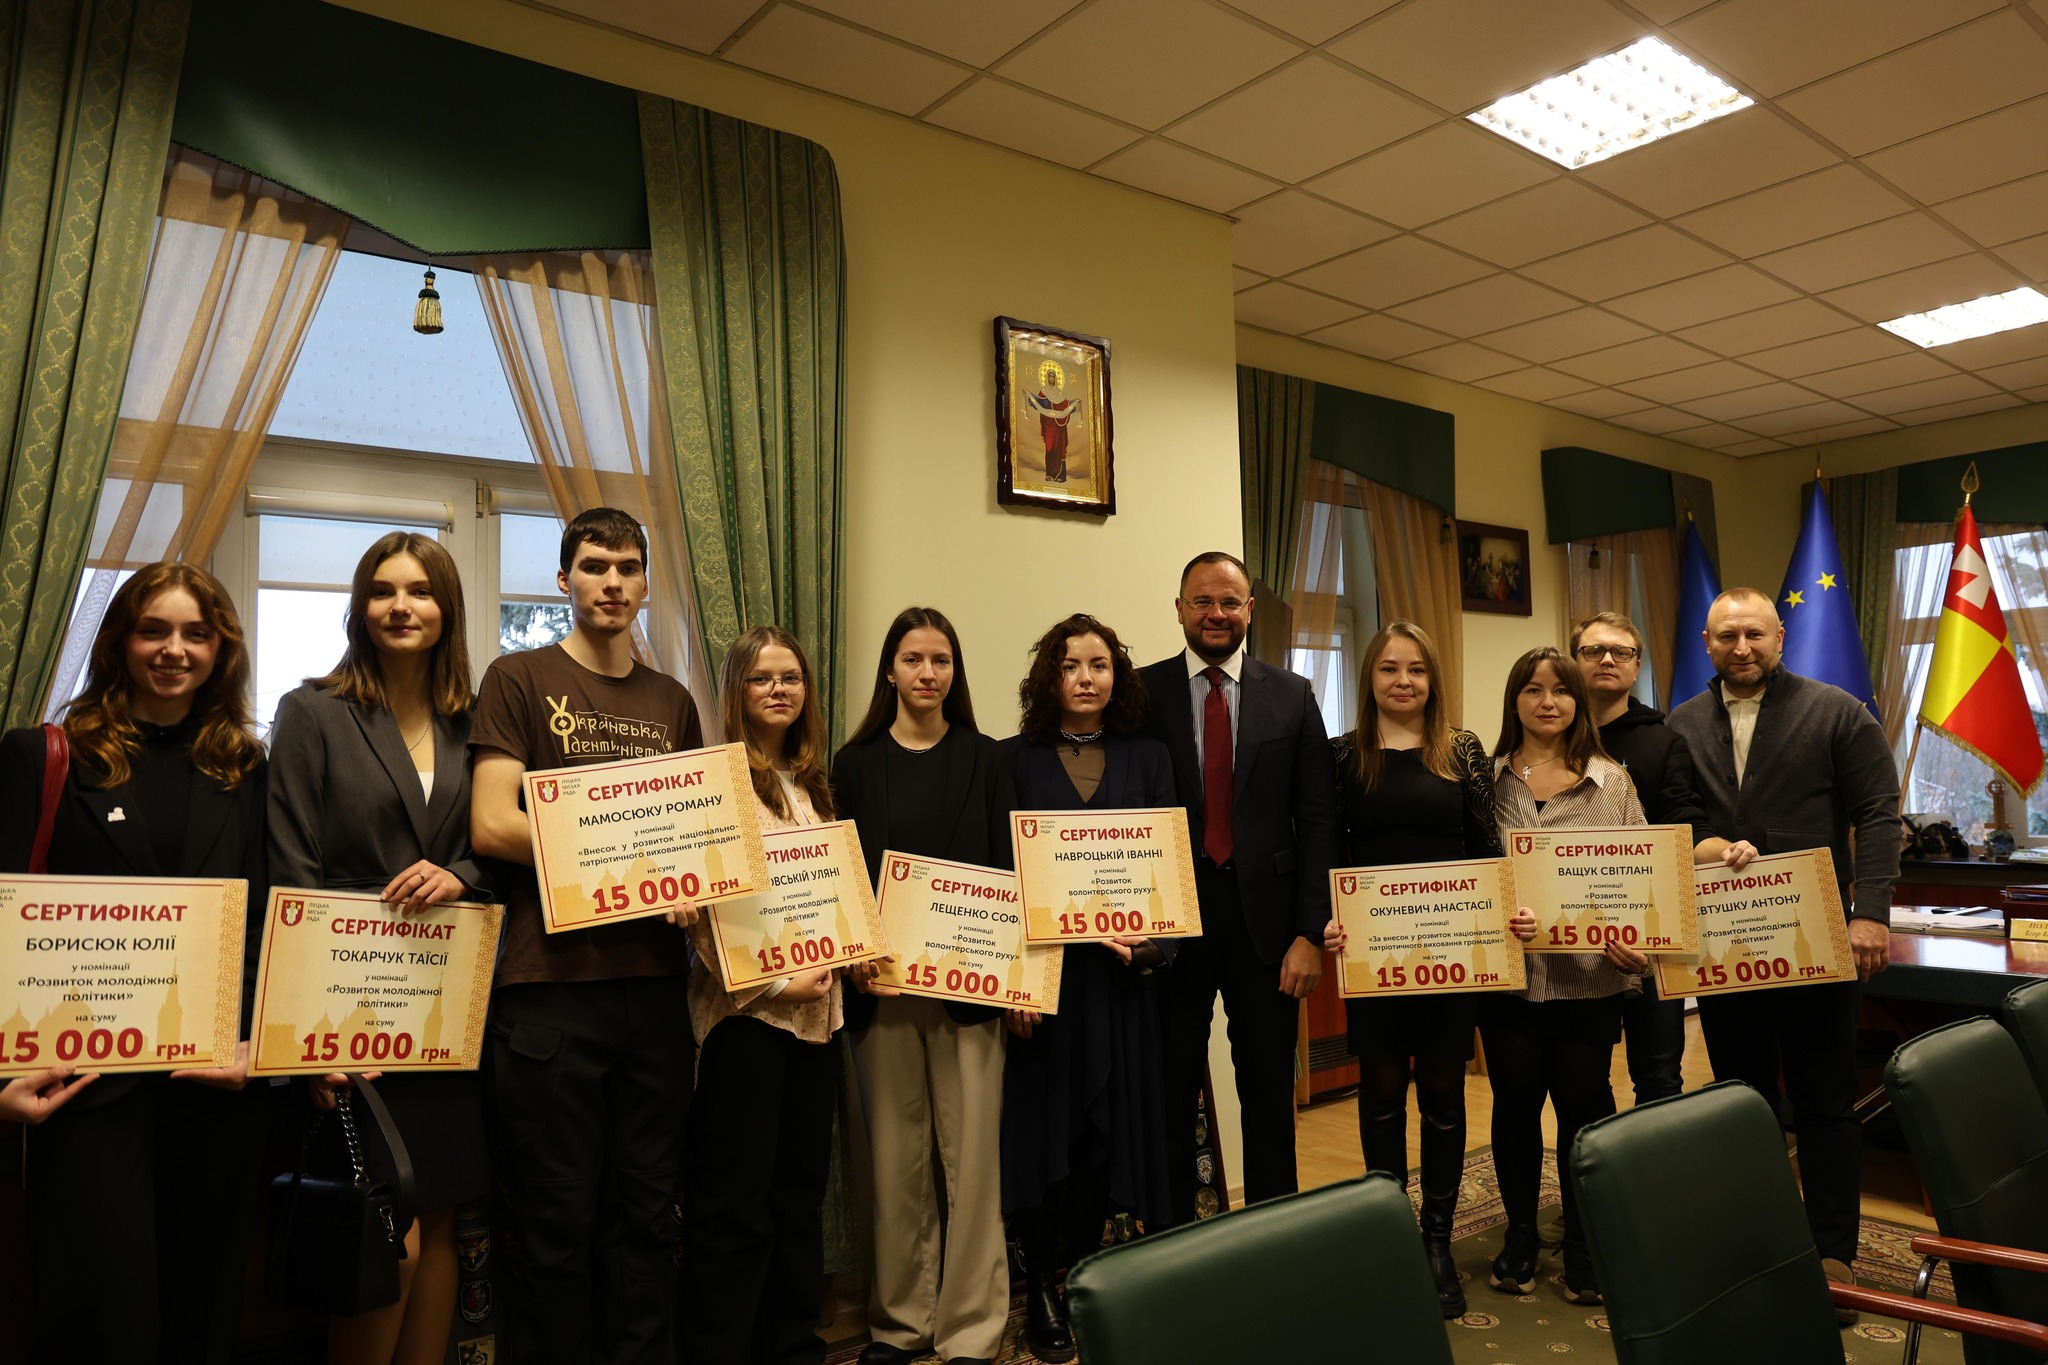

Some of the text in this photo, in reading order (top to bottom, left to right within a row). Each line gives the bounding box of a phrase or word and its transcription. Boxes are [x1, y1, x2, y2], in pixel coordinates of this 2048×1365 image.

[588, 771, 705, 801] СЕРТИФІКАТ
[579, 795, 722, 827] МАМОСЮКУ РОМАНУ
[640, 823, 675, 835] номінації
[1060, 827, 1152, 841] СЕРТИФІКАТ
[578, 845, 616, 856] «Внесок
[633, 836, 674, 849] розвиток
[680, 825, 739, 840] національно-
[580, 834, 741, 868] патріотичного виховання громадян»
[766, 844, 829, 864] ТИФІКАТ
[1055, 849, 1162, 862] НАВРОЦЬКІЙ ІВАННІ
[1555, 844, 1653, 857] СЕРТИФІКАТ
[658, 864, 676, 873] суму
[811, 867, 840, 880] УЛЯНІ
[1558, 866, 1652, 877] ВАЩУК СВІТЛАНІ
[1091, 878, 1132, 886] «Розвиток
[1380, 878, 1477, 896] СЕРТИФІКАТ
[592, 873, 739, 914] 15 000 грн
[787, 890, 812, 900] номінації
[931, 879, 1018, 903] СЕРТИФІК
[1069, 888, 1132, 897] волонтерського
[759, 895, 839, 916] «Розвиток молодіжної
[1370, 899, 1492, 917] ОКУНЕВИЧ АНАСТАСІЇ
[1561, 903, 1627, 911] волонтерського
[1751, 894, 1800, 909] АНТОНУ
[20, 903, 187, 921] СЕРТИФІКАТ
[784, 912, 819, 923] політики»
[930, 902, 988, 919] ЛЕЩЕНКО
[1059, 910, 1175, 934] 15 000 грн
[1736, 915, 1767, 924] номінації
[331, 918, 455, 940] СЕРТИФІКАТ
[802, 928, 815, 937] суму
[964, 926, 993, 934] номінації
[1418, 932, 1451, 941] розвиток
[1454, 929, 1503, 938] національно-
[1548, 925, 1670, 947] 15 000 грн
[1703, 920, 1800, 938] «Розвиток молодіжної
[26, 935, 176, 951] БОРИСЮК ЮЛІЇ
[952, 934, 996, 947] «Розвиток
[1369, 942, 1422, 952] патріотичного
[1464, 938, 1504, 947] громадян»
[1731, 934, 1774, 946] політики»
[331, 949, 448, 965] ТОКАРЧУК ТАЇСІЇ
[758, 936, 864, 973] 15 000 грн
[926, 941, 1020, 961] волонтерського руху»
[1377, 963, 1498, 987] 15 000 грн
[1696, 958, 1825, 987] 15 000 грн
[18, 975, 178, 988] «Розвиток молодіжної
[906, 964, 1031, 1002] 15 000 грн
[63, 992, 133, 1002] політики»
[327, 985, 442, 997] «Розвиток молодіжної
[357, 999, 408, 1008] політики»
[91, 1014, 116, 1022] суму
[56, 1028, 143, 1060] 000
[156, 1043, 195, 1060] грн
[301, 1032, 450, 1062] 15 000 грн
